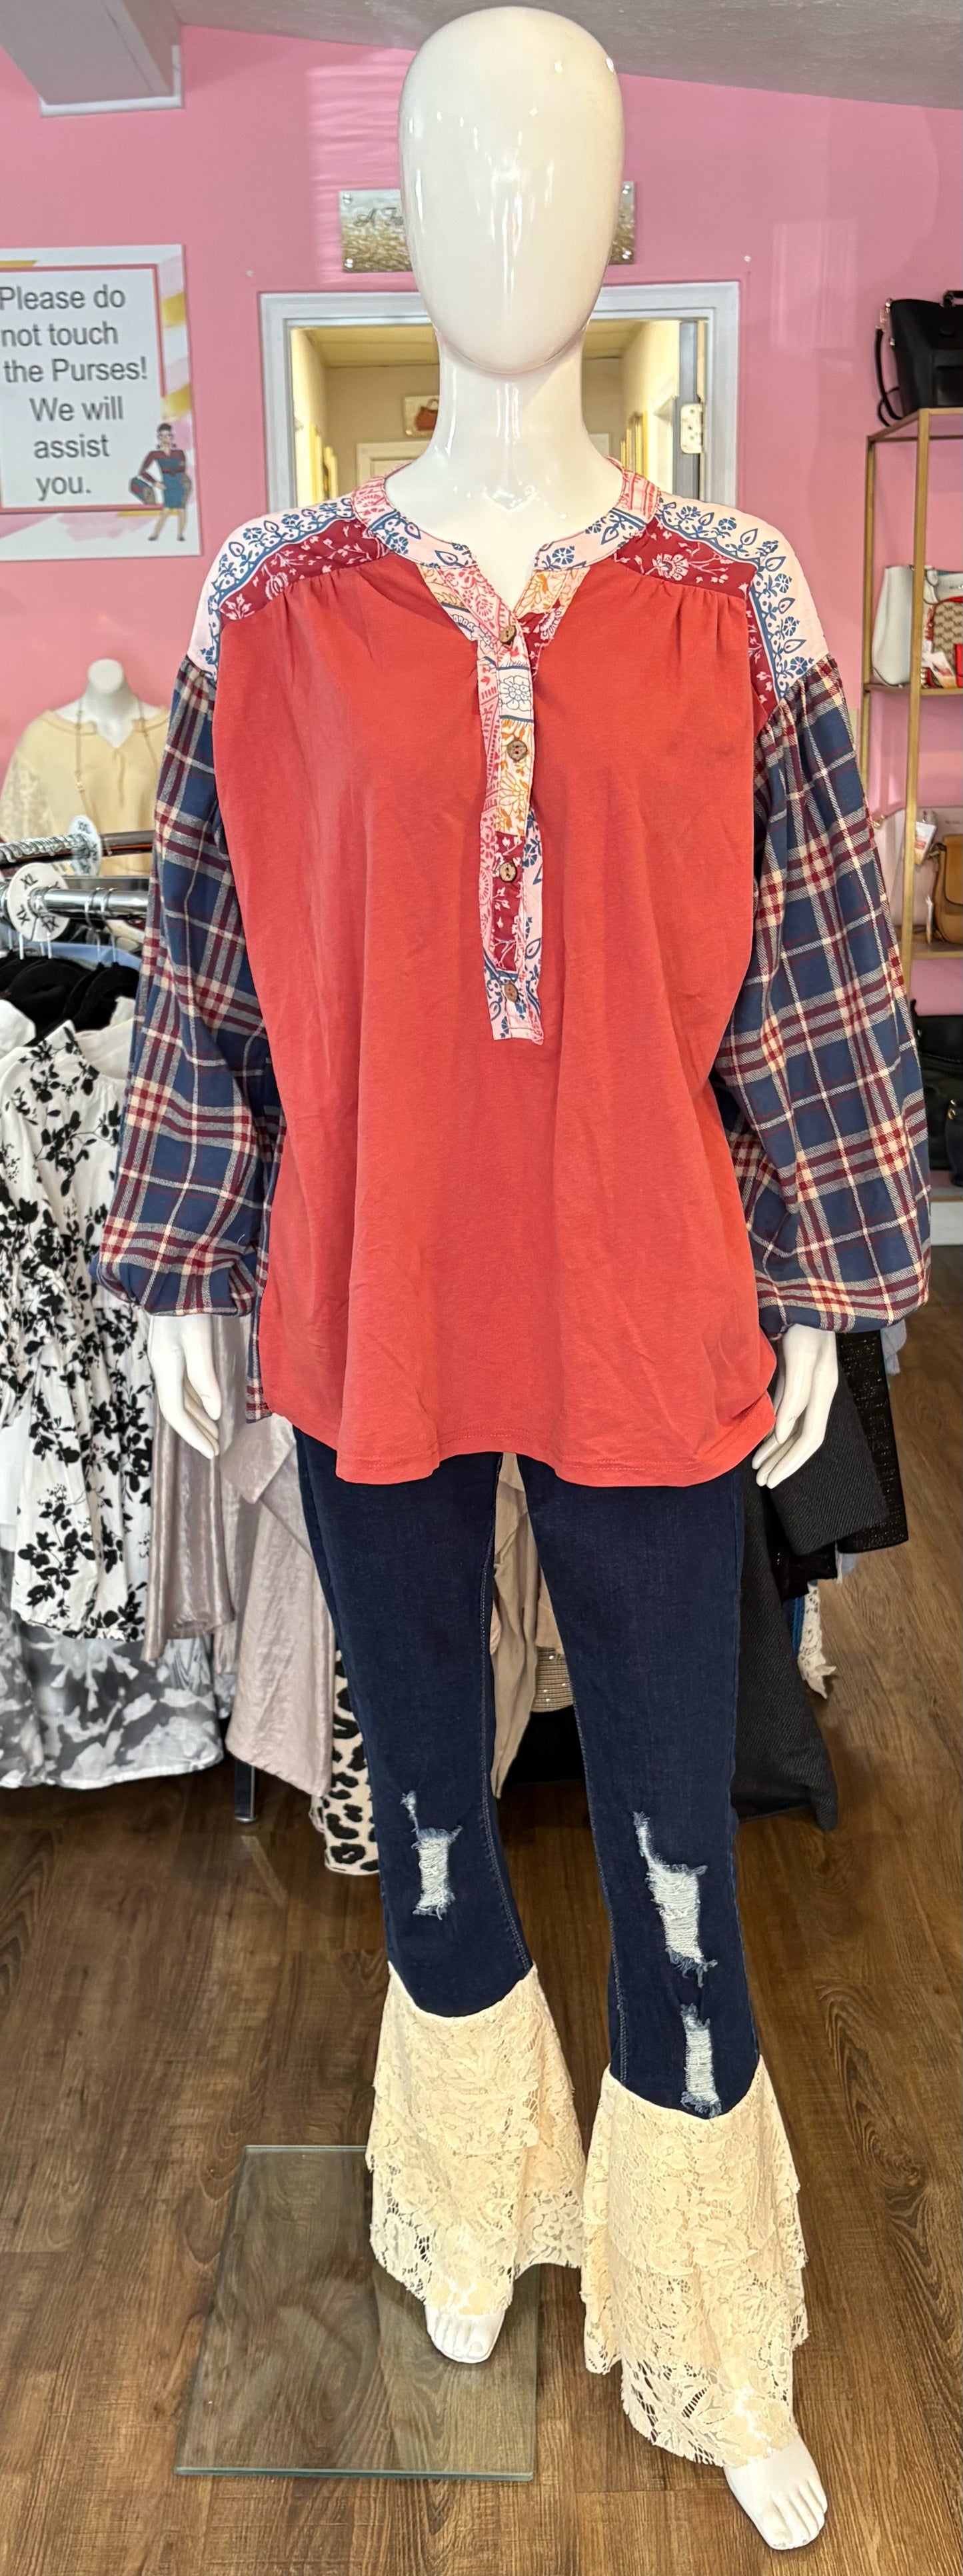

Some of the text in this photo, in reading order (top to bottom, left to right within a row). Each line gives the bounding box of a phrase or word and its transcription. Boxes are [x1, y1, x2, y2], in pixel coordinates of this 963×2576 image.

[0, 284, 126, 310] Please do
[1, 321, 119, 347] not touch
[4, 356, 148, 383] the Purses!
[29, 396, 123, 421] We will
[34, 434, 110, 459] assist
[36, 477, 91, 501] you.
[20, 873, 38, 890] XL
[16, 905, 30, 925] XL
